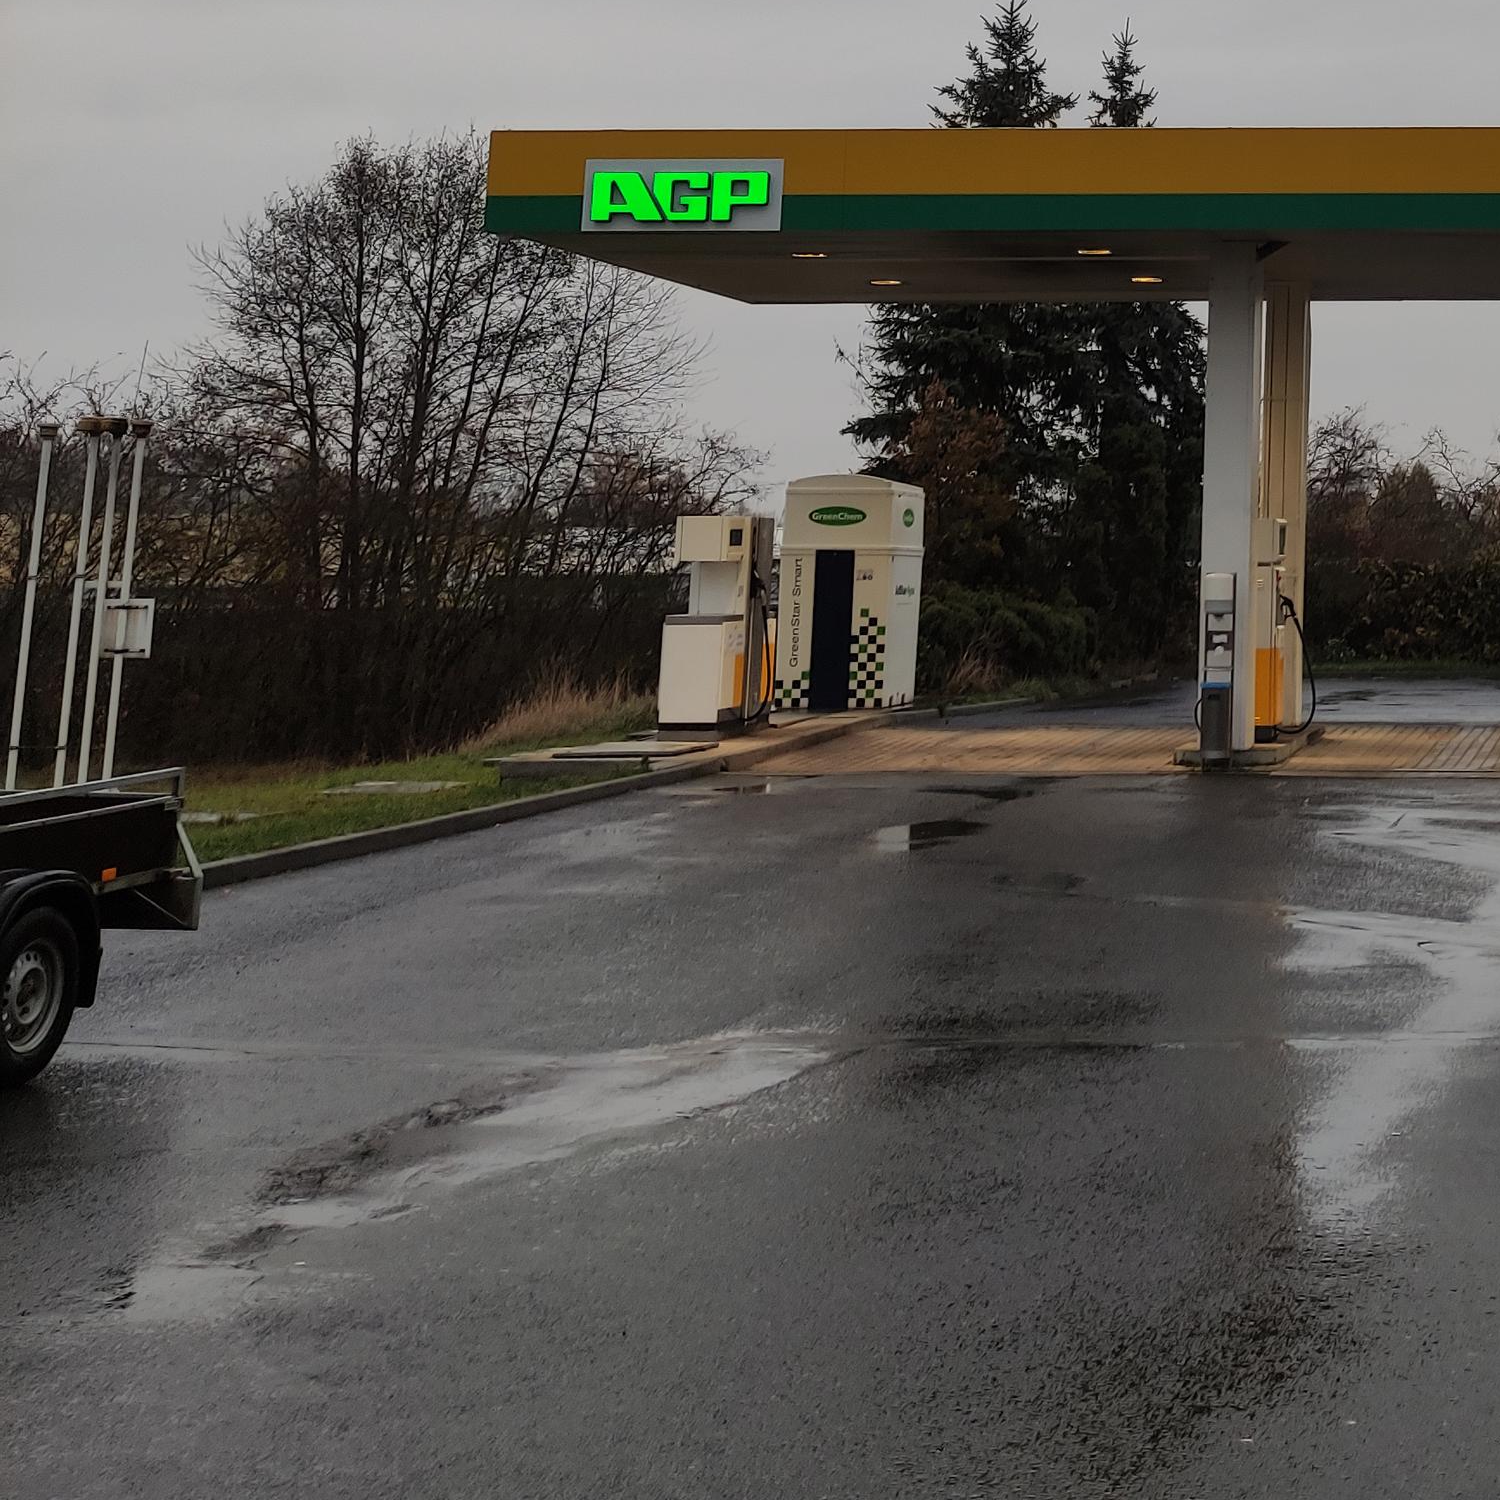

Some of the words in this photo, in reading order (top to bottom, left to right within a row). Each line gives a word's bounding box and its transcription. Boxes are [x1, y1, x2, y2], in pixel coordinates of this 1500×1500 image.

[590, 172, 769, 221] AGP
[811, 511, 864, 521] GreenChem
[792, 557, 803, 597] Smart
[789, 600, 801, 668] GreenStar
